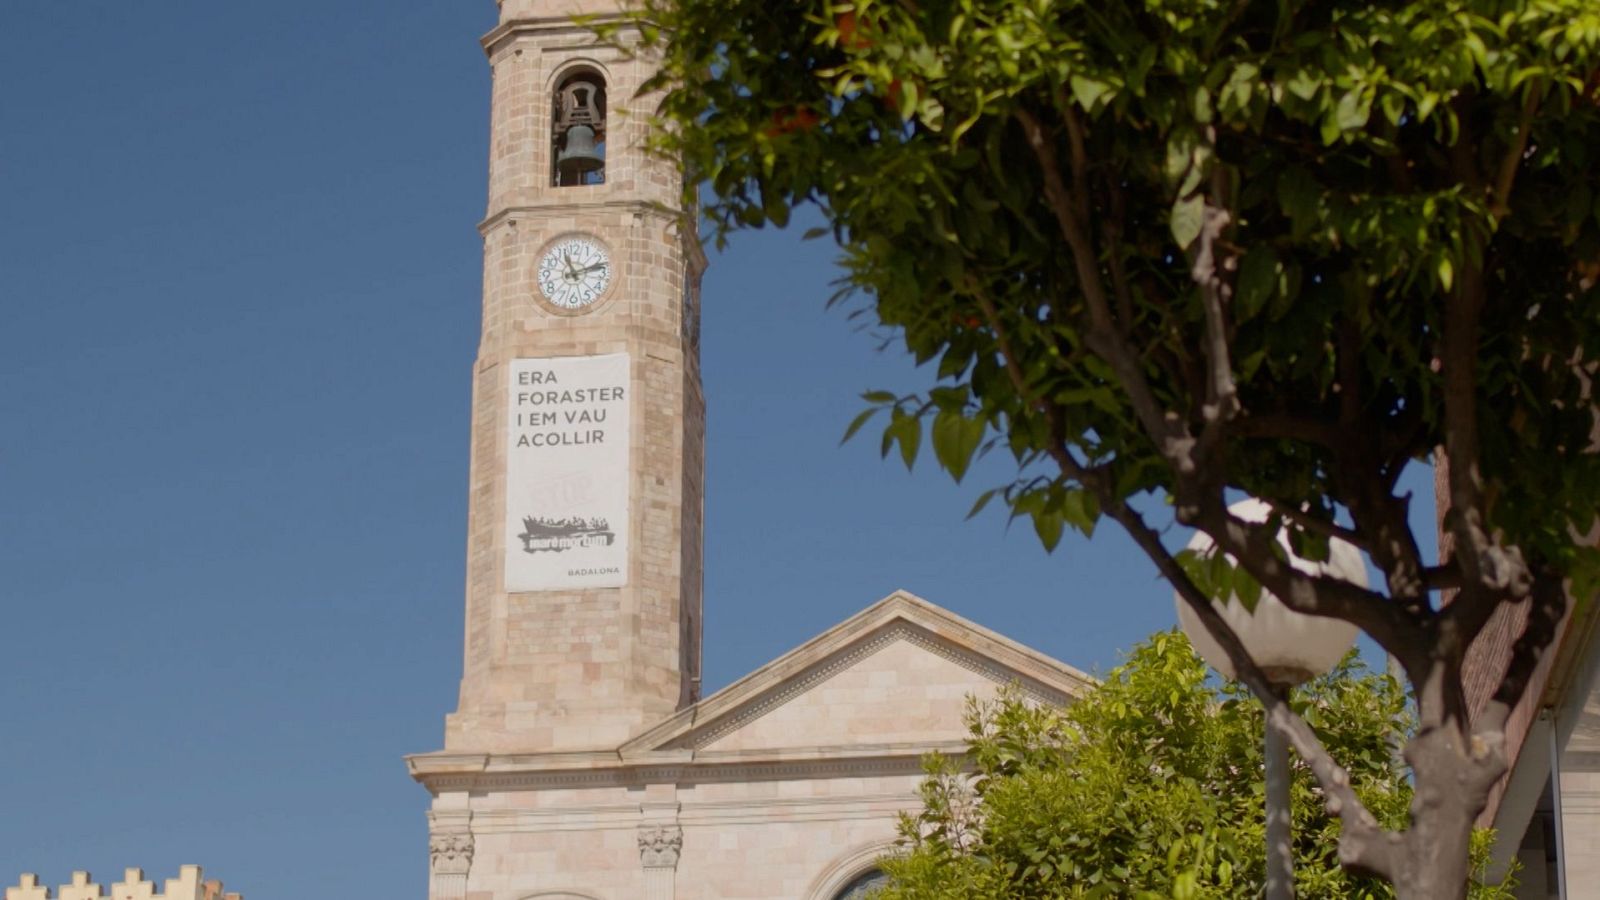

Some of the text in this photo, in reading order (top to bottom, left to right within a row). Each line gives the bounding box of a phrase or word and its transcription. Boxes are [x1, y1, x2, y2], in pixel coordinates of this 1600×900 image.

[570, 244, 580, 255] 12
[542, 269, 551, 281] 9
[547, 281, 555, 294] 8
[593, 281, 601, 291] 4
[570, 291, 578, 304] 6
[584, 290, 591, 301] 5
[518, 370, 558, 386] ERA
[518, 386, 625, 406] FORASTER
[517, 408, 607, 427] I EM VAU
[517, 430, 605, 448] ACOLLIR
[568, 567, 620, 577] BADALONA
